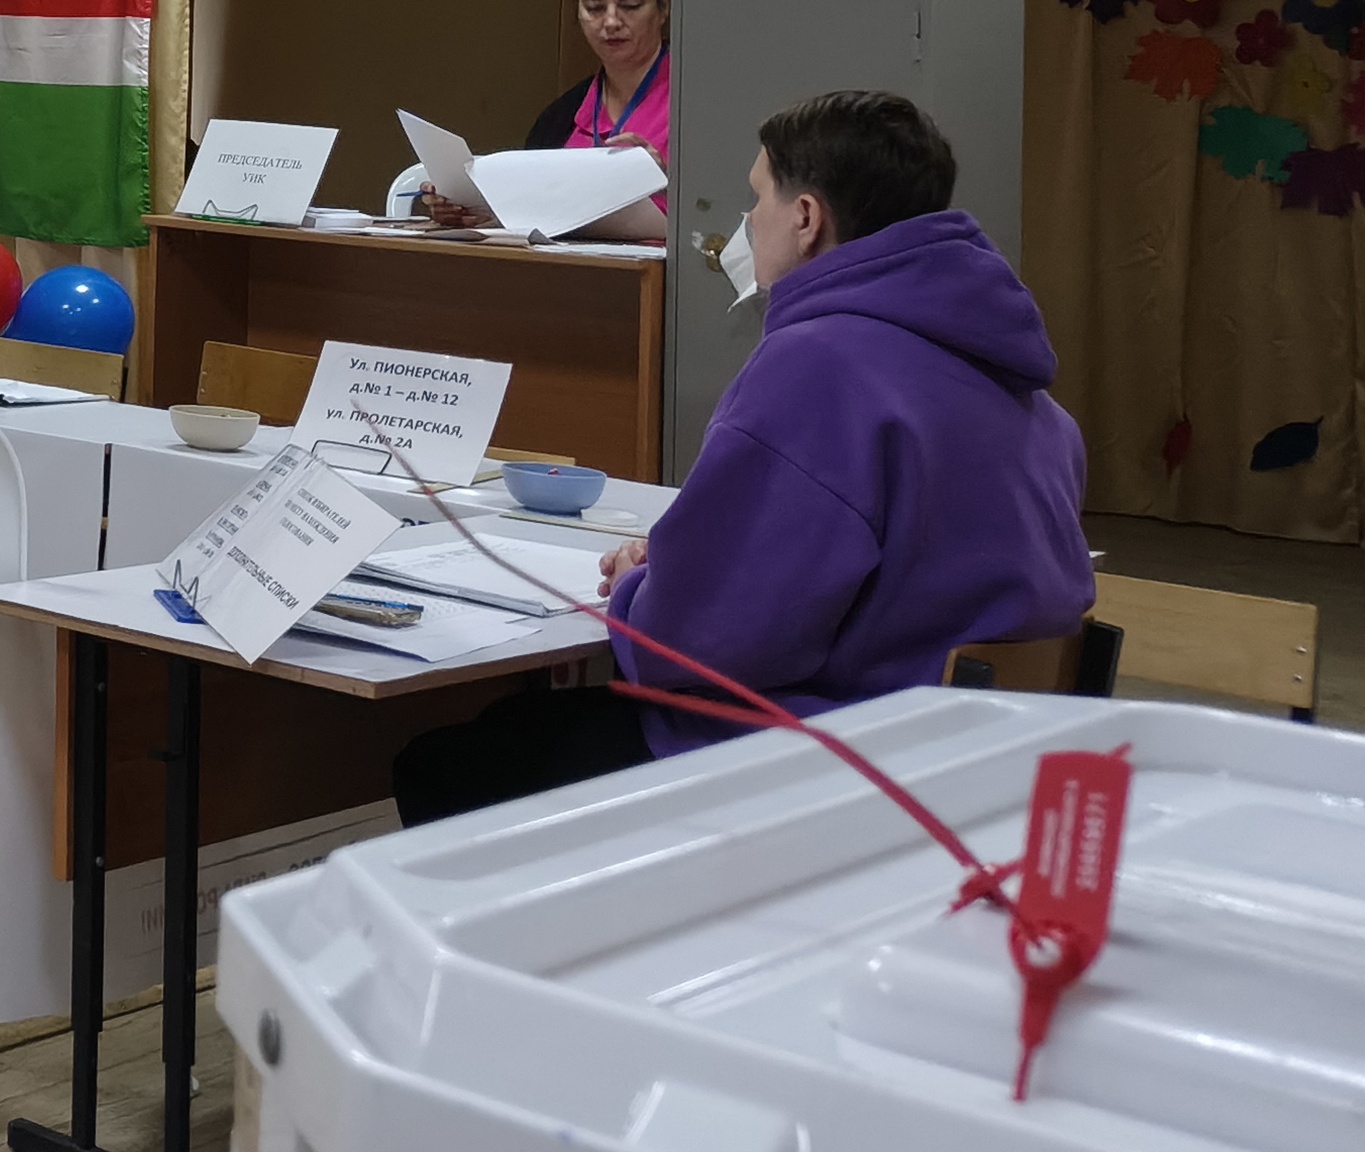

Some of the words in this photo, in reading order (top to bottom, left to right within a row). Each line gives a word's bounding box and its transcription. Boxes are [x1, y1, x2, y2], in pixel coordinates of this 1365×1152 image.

[217, 153, 303, 169] ПРЕДСЕДАТЕЛЬ
[242, 172, 267, 184] УИК
[349, 358, 369, 371] Ул.
[373, 361, 472, 388] ПИОНЕРСКАЯ,
[349, 382, 381, 395] д.№
[384, 385, 392, 396] 1
[405, 390, 439, 403] д.№
[441, 393, 459, 406] 12
[326, 408, 345, 420] ул.
[349, 410, 464, 439] ПРОЛЕТАРСКАЯ,
[359, 434, 391, 447] д.№
[394, 437, 413, 449] 2А
[267, 578, 300, 611] СПИСКИ
